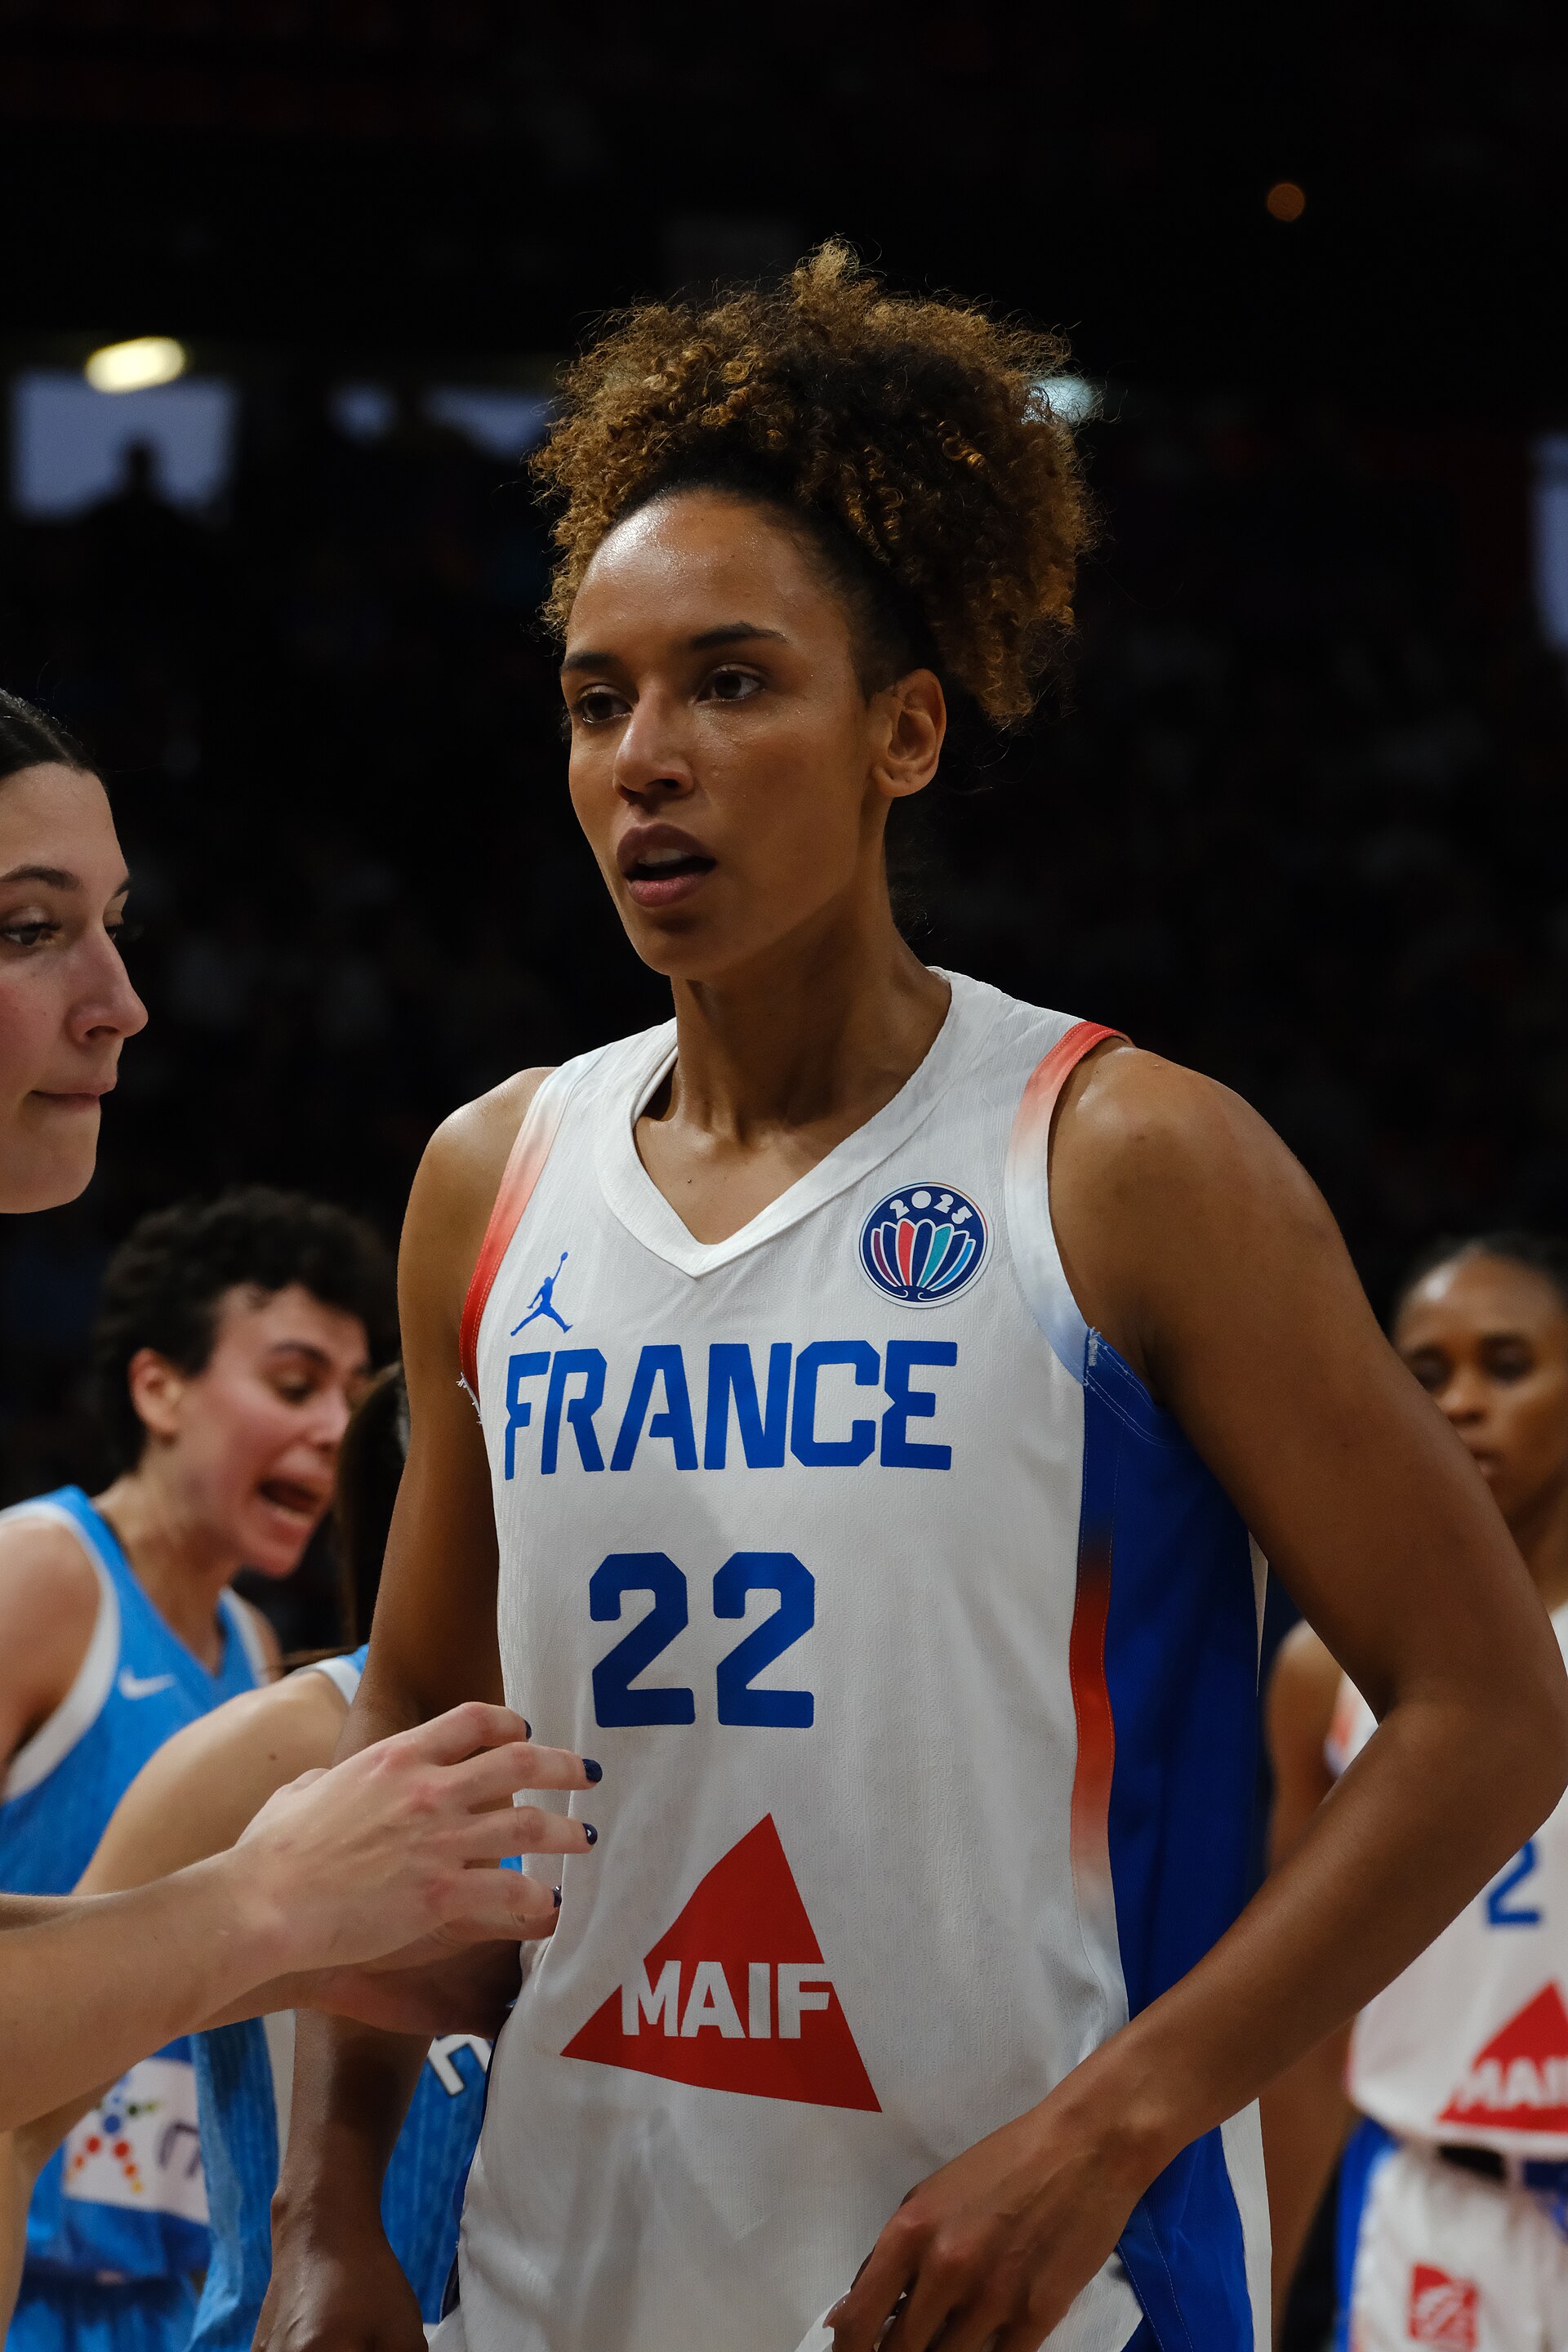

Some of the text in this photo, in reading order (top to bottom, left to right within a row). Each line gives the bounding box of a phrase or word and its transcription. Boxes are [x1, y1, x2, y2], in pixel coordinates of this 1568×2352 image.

[889, 1190, 973, 1224] 2025
[505, 1339, 958, 1481] FRANCE
[589, 1551, 815, 1729] 22
[1486, 1839, 1540, 1927] 2
[621, 1960, 831, 2039] MAIF
